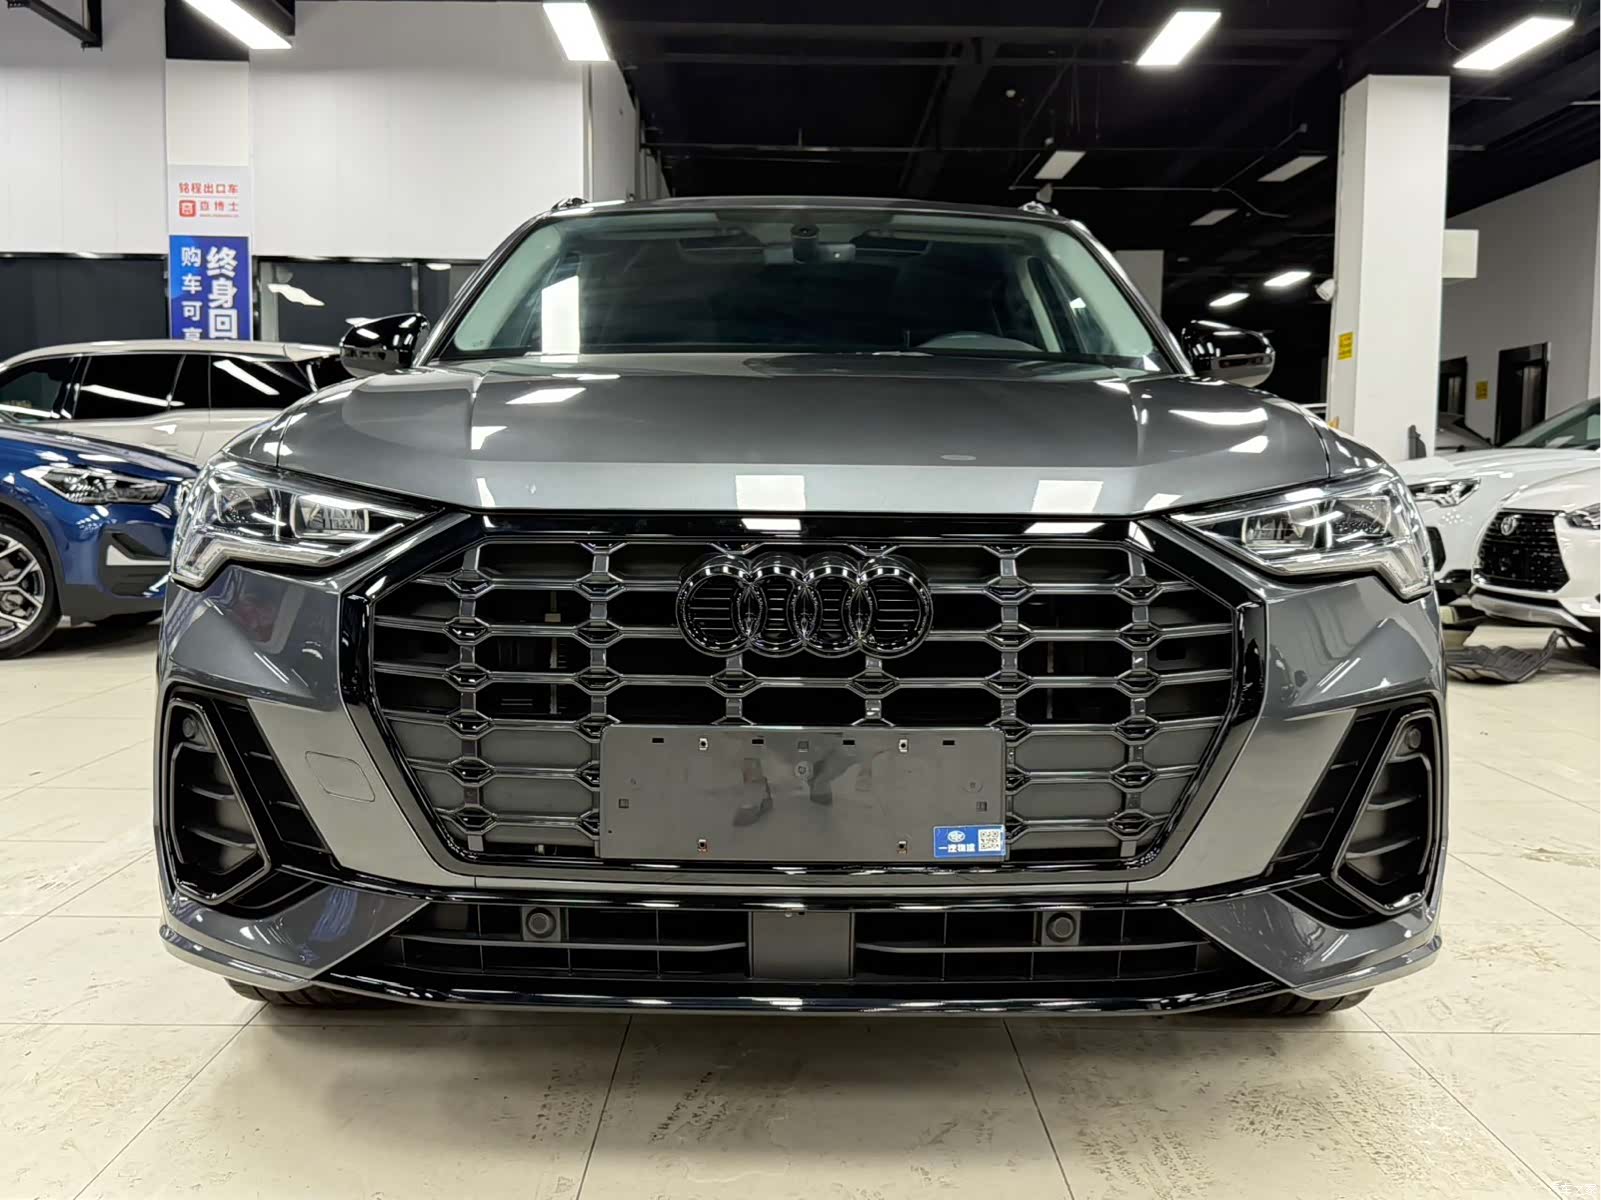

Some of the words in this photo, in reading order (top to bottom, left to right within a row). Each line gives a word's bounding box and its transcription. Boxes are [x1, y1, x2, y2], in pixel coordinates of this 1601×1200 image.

[179, 182, 239, 194] 铭程出口车
[206, 246, 238, 340] 终身回
